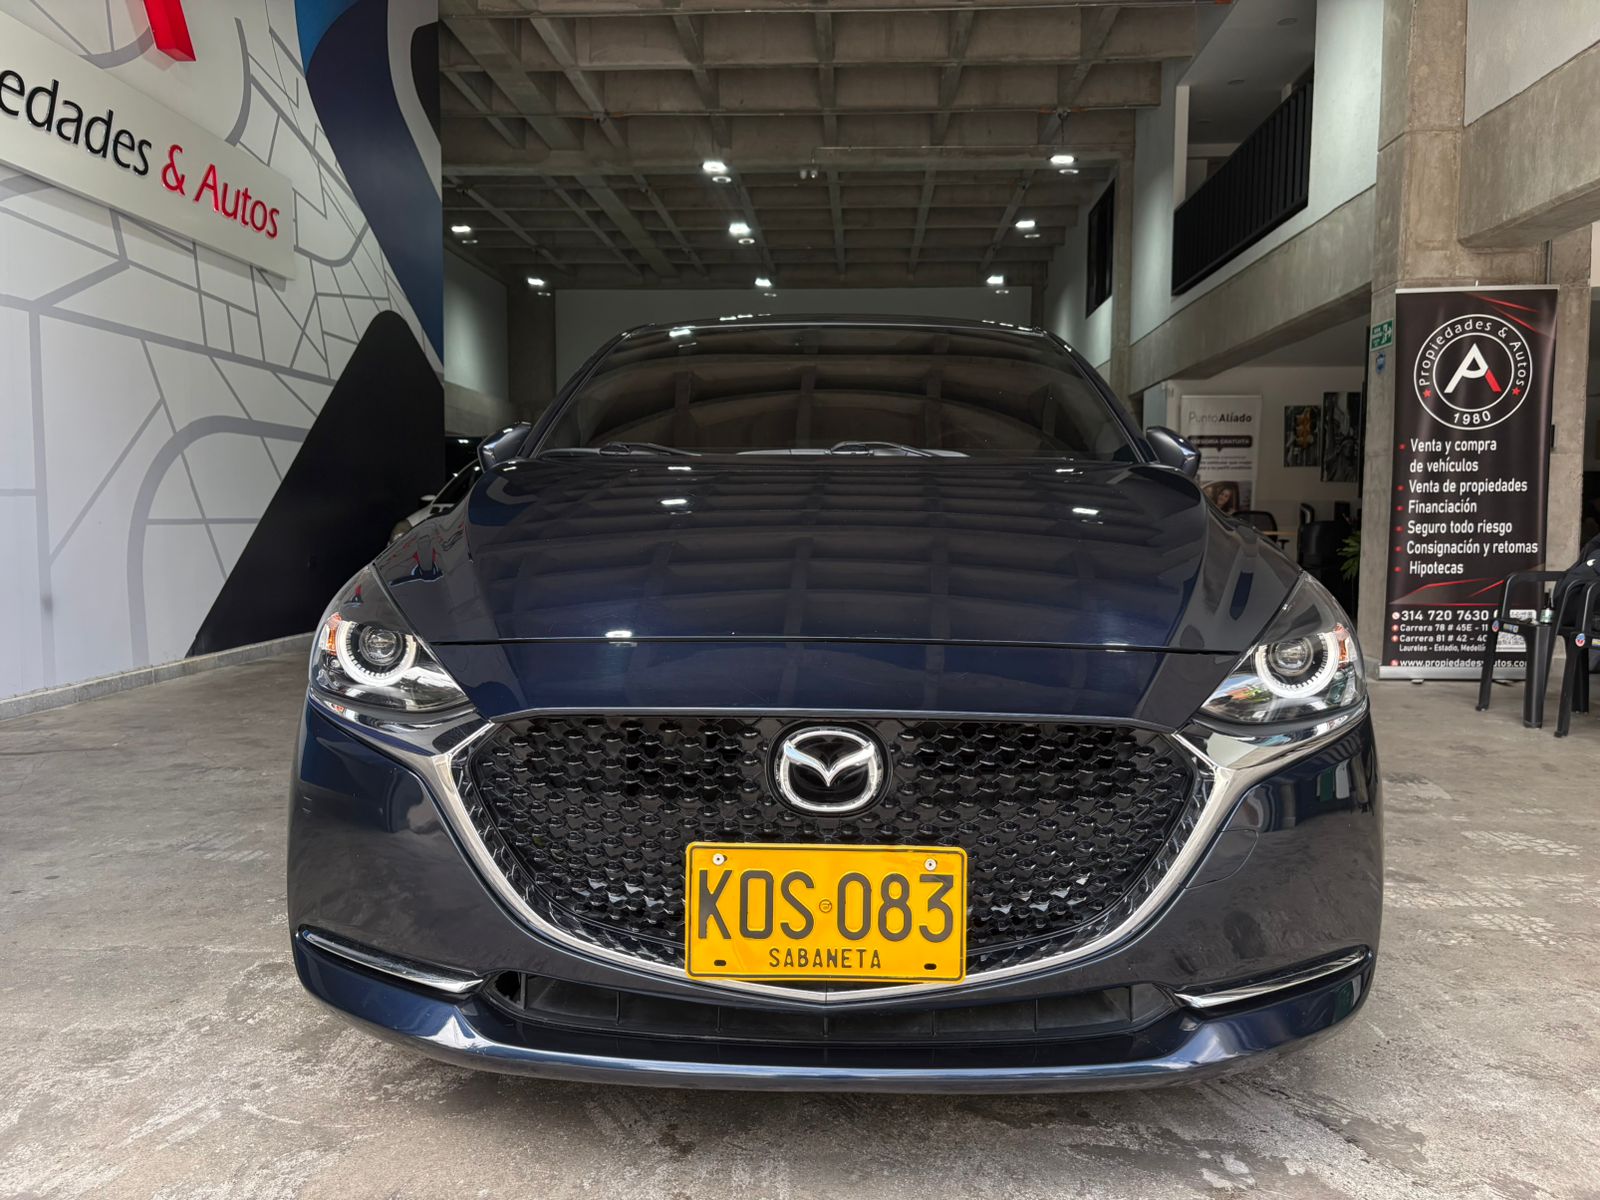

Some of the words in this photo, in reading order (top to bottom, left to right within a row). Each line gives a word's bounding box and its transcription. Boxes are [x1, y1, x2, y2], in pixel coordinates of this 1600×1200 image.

[0, 69, 152, 176] edades
[161, 143, 186, 197] &
[194, 164, 281, 240] Autos
[1419, 319, 1492, 386] Propiedades
[1497, 327, 1508, 339] &
[1509, 341, 1527, 387] Autos
[1453, 410, 1492, 425] 1980
[1410, 438, 1442, 452] Venta
[1445, 441, 1452, 455] y
[1454, 439, 1497, 455] compra
[1409, 459, 1423, 473] de
[1426, 458, 1479, 472] vehículos
[1408, 480, 1440, 493] Venta
[1443, 479, 1456, 492] de
[1459, 478, 1528, 495] propiedades
[1408, 498, 1477, 514] Financiación
[1407, 520, 1447, 537] Seguro
[1450, 520, 1474, 533] todo
[1477, 520, 1513, 536] riesgo
[1406, 538, 1480, 557] Consignación
[1483, 544, 1490, 556] y
[1493, 541, 1538, 553] retomas
[1409, 561, 1464, 577] Hipotecas
[1401, 610, 1423, 621] 314
[1428, 610, 1452, 621] 720
[1456, 610, 1489, 621] 7630
[1399, 624, 1433, 632] Carrera
[1436, 624, 1445, 632] 78
[1447, 624, 1454, 632] #
[1399, 634, 1433, 642] Carrera
[1436, 634, 1445, 642] 81
[1447, 634, 1454, 642] #
[1456, 634, 1467, 642] 42
[1399, 644, 1428, 652] Laureles
[698, 869, 815, 940] KOS
[836, 871, 954, 943] 083
[768, 947, 882, 969] SABANETA
